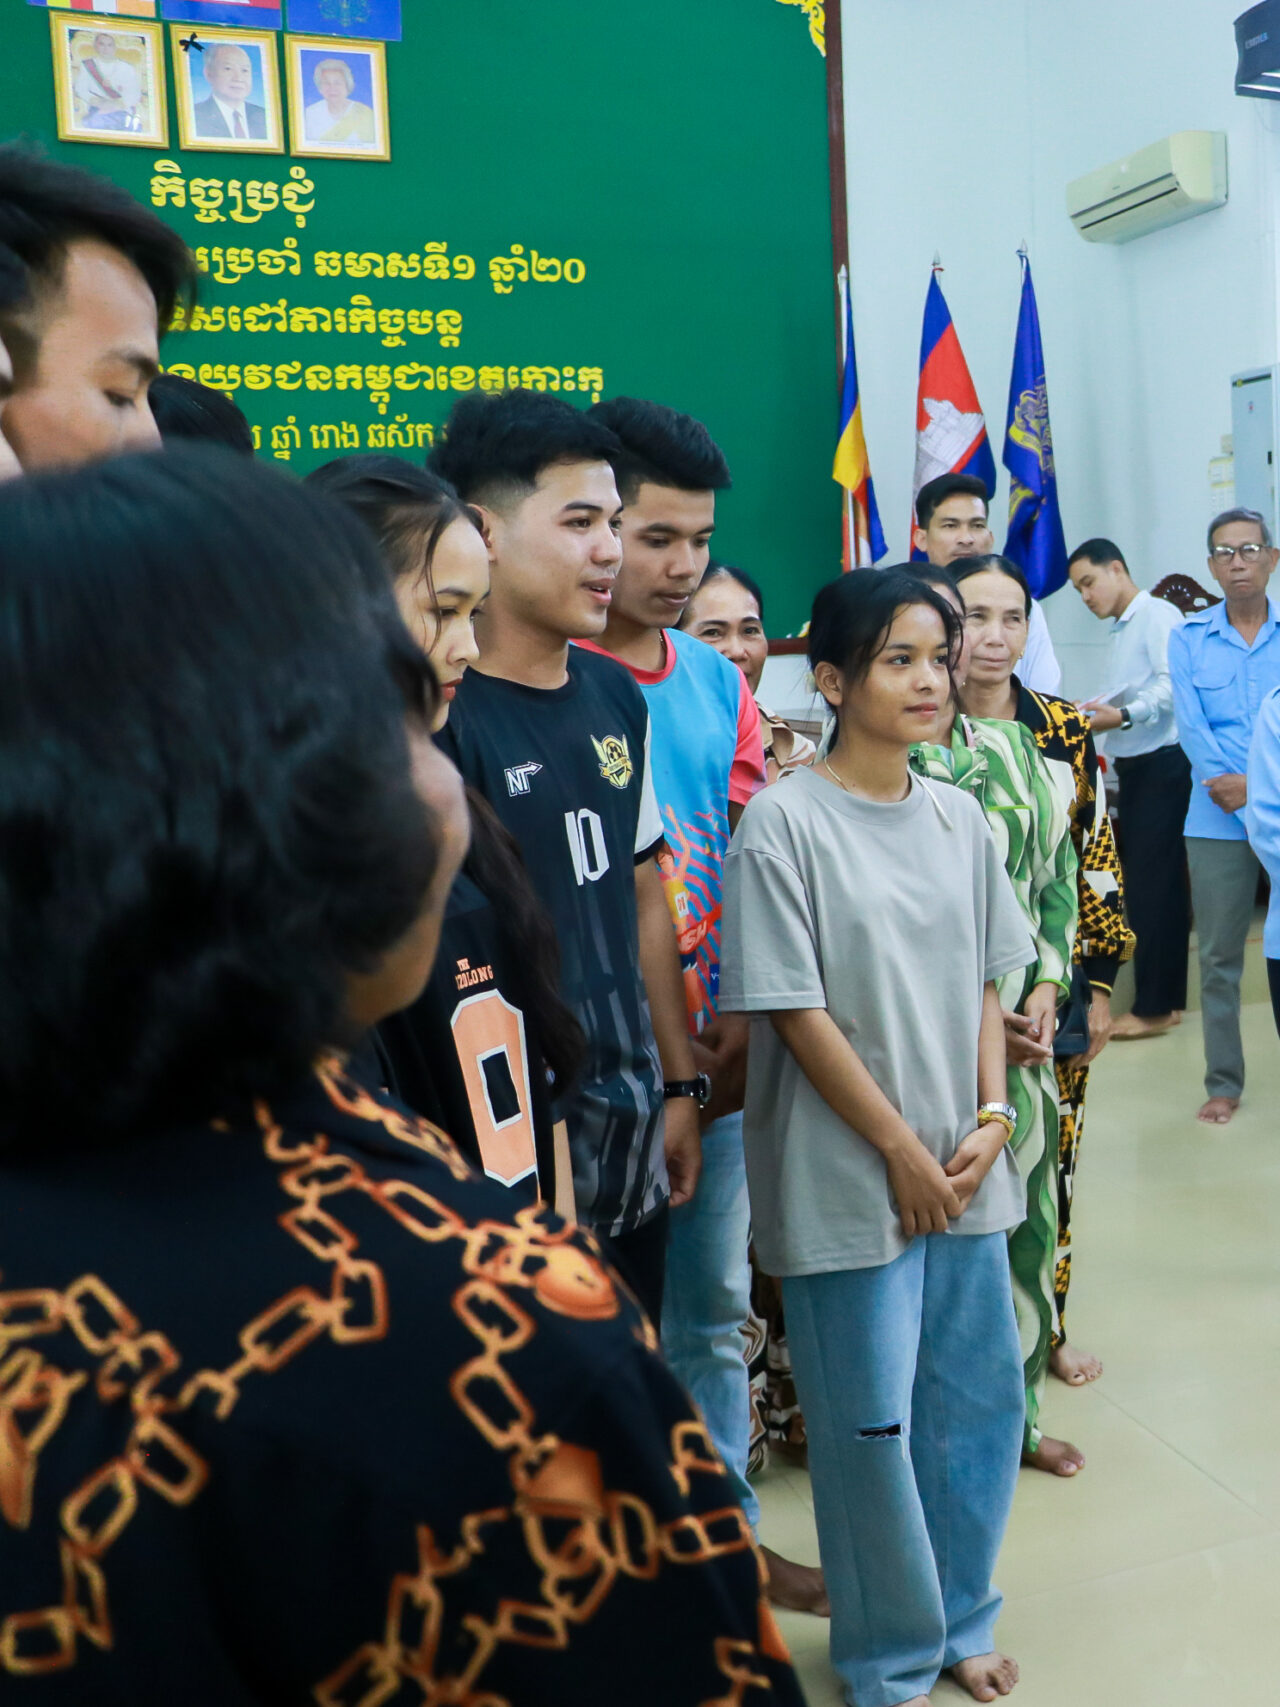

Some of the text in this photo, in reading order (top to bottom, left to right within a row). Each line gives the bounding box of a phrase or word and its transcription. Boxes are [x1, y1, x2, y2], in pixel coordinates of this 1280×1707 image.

[150, 159, 315, 228] កិច្ចប្រជុំ
[314, 241, 476, 280] ឆមាសទី១
[564, 808, 610, 886] 10
